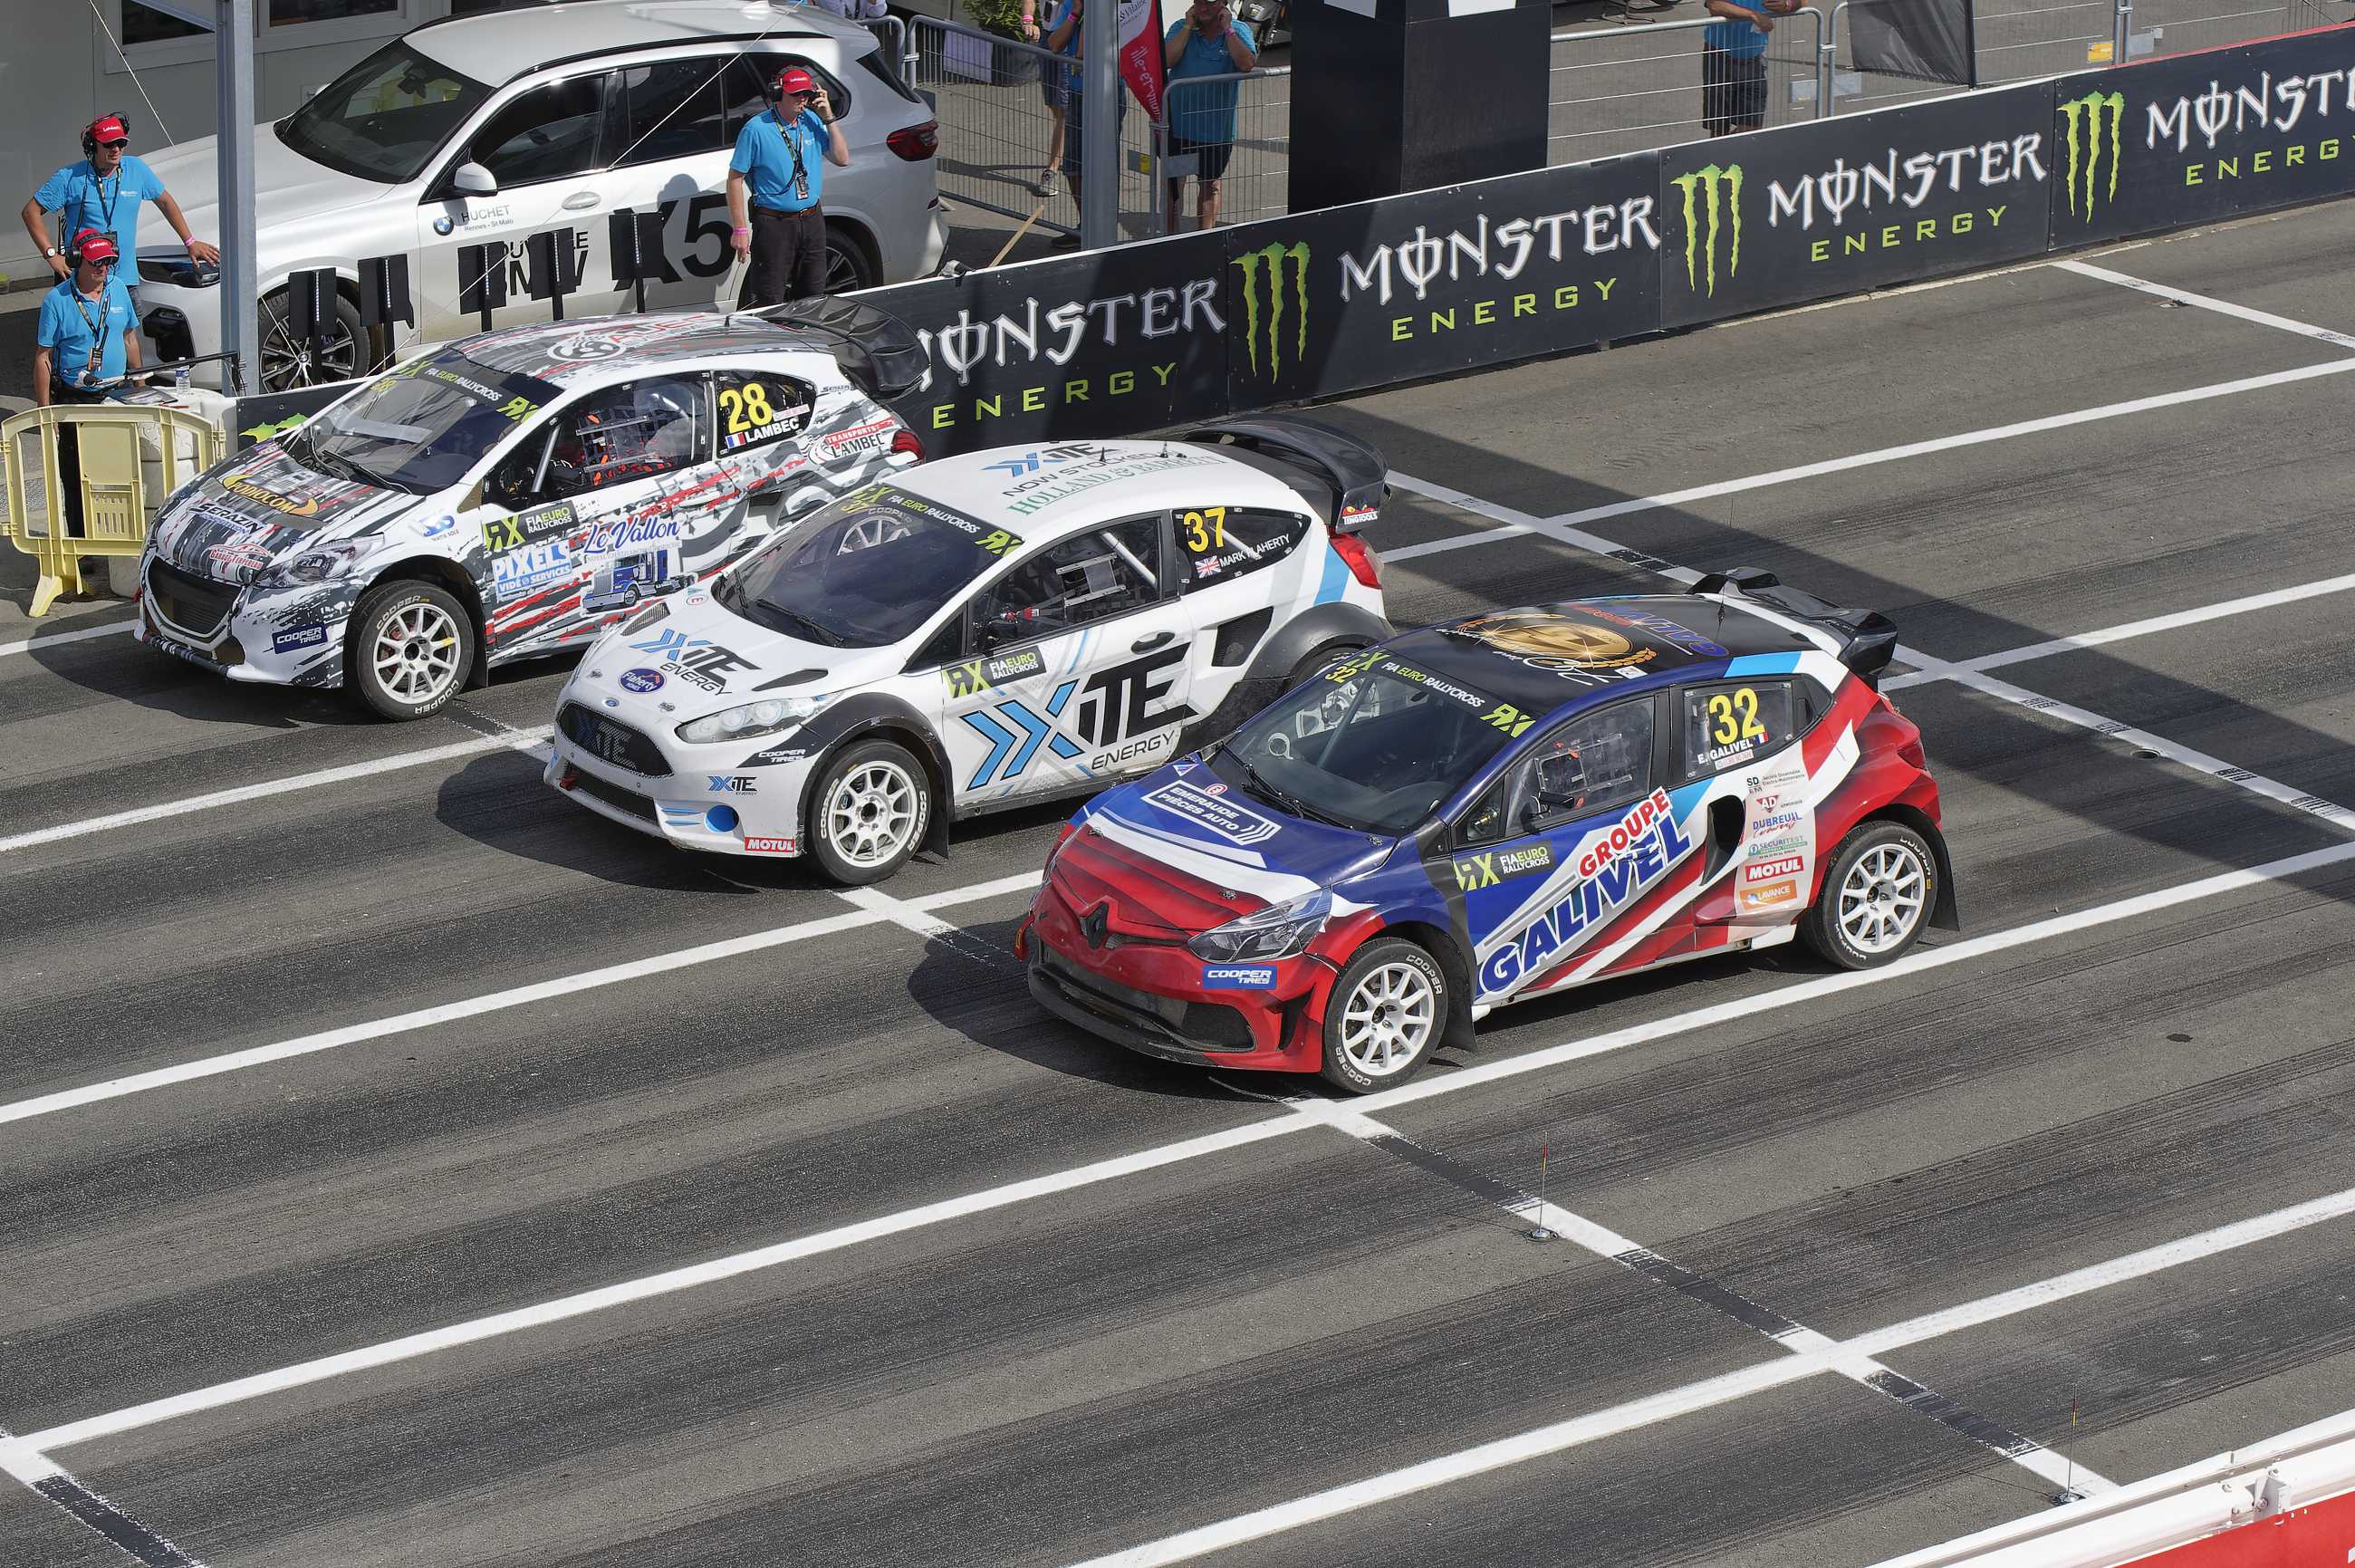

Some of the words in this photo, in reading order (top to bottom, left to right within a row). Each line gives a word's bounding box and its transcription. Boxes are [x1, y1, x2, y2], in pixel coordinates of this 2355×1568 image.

[2147, 67, 2355, 153] MONST
[2186, 134, 2355, 186] ENERG
[1767, 132, 2047, 231] MONSTER
[460, 204, 510, 223] HUCHET
[464, 223, 486, 232] Rennes
[1338, 195, 1661, 305] MONSTER
[1811, 205, 2007, 263] ENERGY
[1392, 277, 1617, 342] ENERGY
[457, 377, 502, 402] RALLYCROSS
[932, 361, 1177, 429] ENERGY
[719, 382, 774, 434] 28
[745, 418, 800, 443] LAMBEC
[230, 480, 299, 514] PODIOCOM
[1002, 473, 1058, 498] NOW
[1005, 471, 1112, 517] HOLLAND
[188, 503, 263, 534] SERAZIN
[527, 515, 572, 534] RALLYCROSS
[900, 499, 929, 514] EURO
[925, 507, 981, 534] RALLYCROSS
[1183, 507, 1226, 553] 37
[584, 524, 608, 553] Le
[610, 515, 680, 549] Vallon
[495, 541, 571, 582] PIXELS
[530, 564, 572, 583] SERVICES
[1220, 551, 1245, 568] MARK
[376, 594, 421, 631] COOPER
[276, 627, 322, 644] COOPER
[300, 633, 322, 644] TIRES
[622, 671, 658, 692] Flaherty
[659, 662, 732, 697] ENERGY
[992, 660, 1039, 679] RALLYCROSS
[1324, 666, 1359, 683] 32
[1381, 661, 1399, 674] FIA
[1396, 667, 1427, 682] EURO
[1423, 677, 1486, 708] RALLYCROSS
[414, 678, 460, 715] COOPER
[1709, 688, 1766, 745] 32
[758, 748, 806, 759] COOPER
[770, 755, 805, 764] TIRES
[1091, 730, 1175, 770] ENERGY
[1697, 753, 1710, 765] E.
[1708, 738, 1754, 761] GALIVEL
[1746, 777, 1760, 786] SD
[1169, 784, 1240, 821] EMERAUDE
[1762, 795, 1778, 810] AD
[907, 790, 928, 852] COOPER
[1203, 809, 1240, 832] AUTO
[1579, 790, 1671, 878] GROUPE
[1753, 812, 1802, 831] DUBREUIL
[747, 838, 794, 852] MOTUL
[1502, 856, 1551, 875] RALLYCROSS
[1748, 858, 1802, 880] MOTUL
[1480, 813, 1692, 994] GALIVEL
[1207, 969, 1273, 979] COOPER
[1237, 976, 1270, 986] TIRES
[1406, 954, 1444, 995] COOPER
[1335, 1044, 1372, 1087] COOPER
